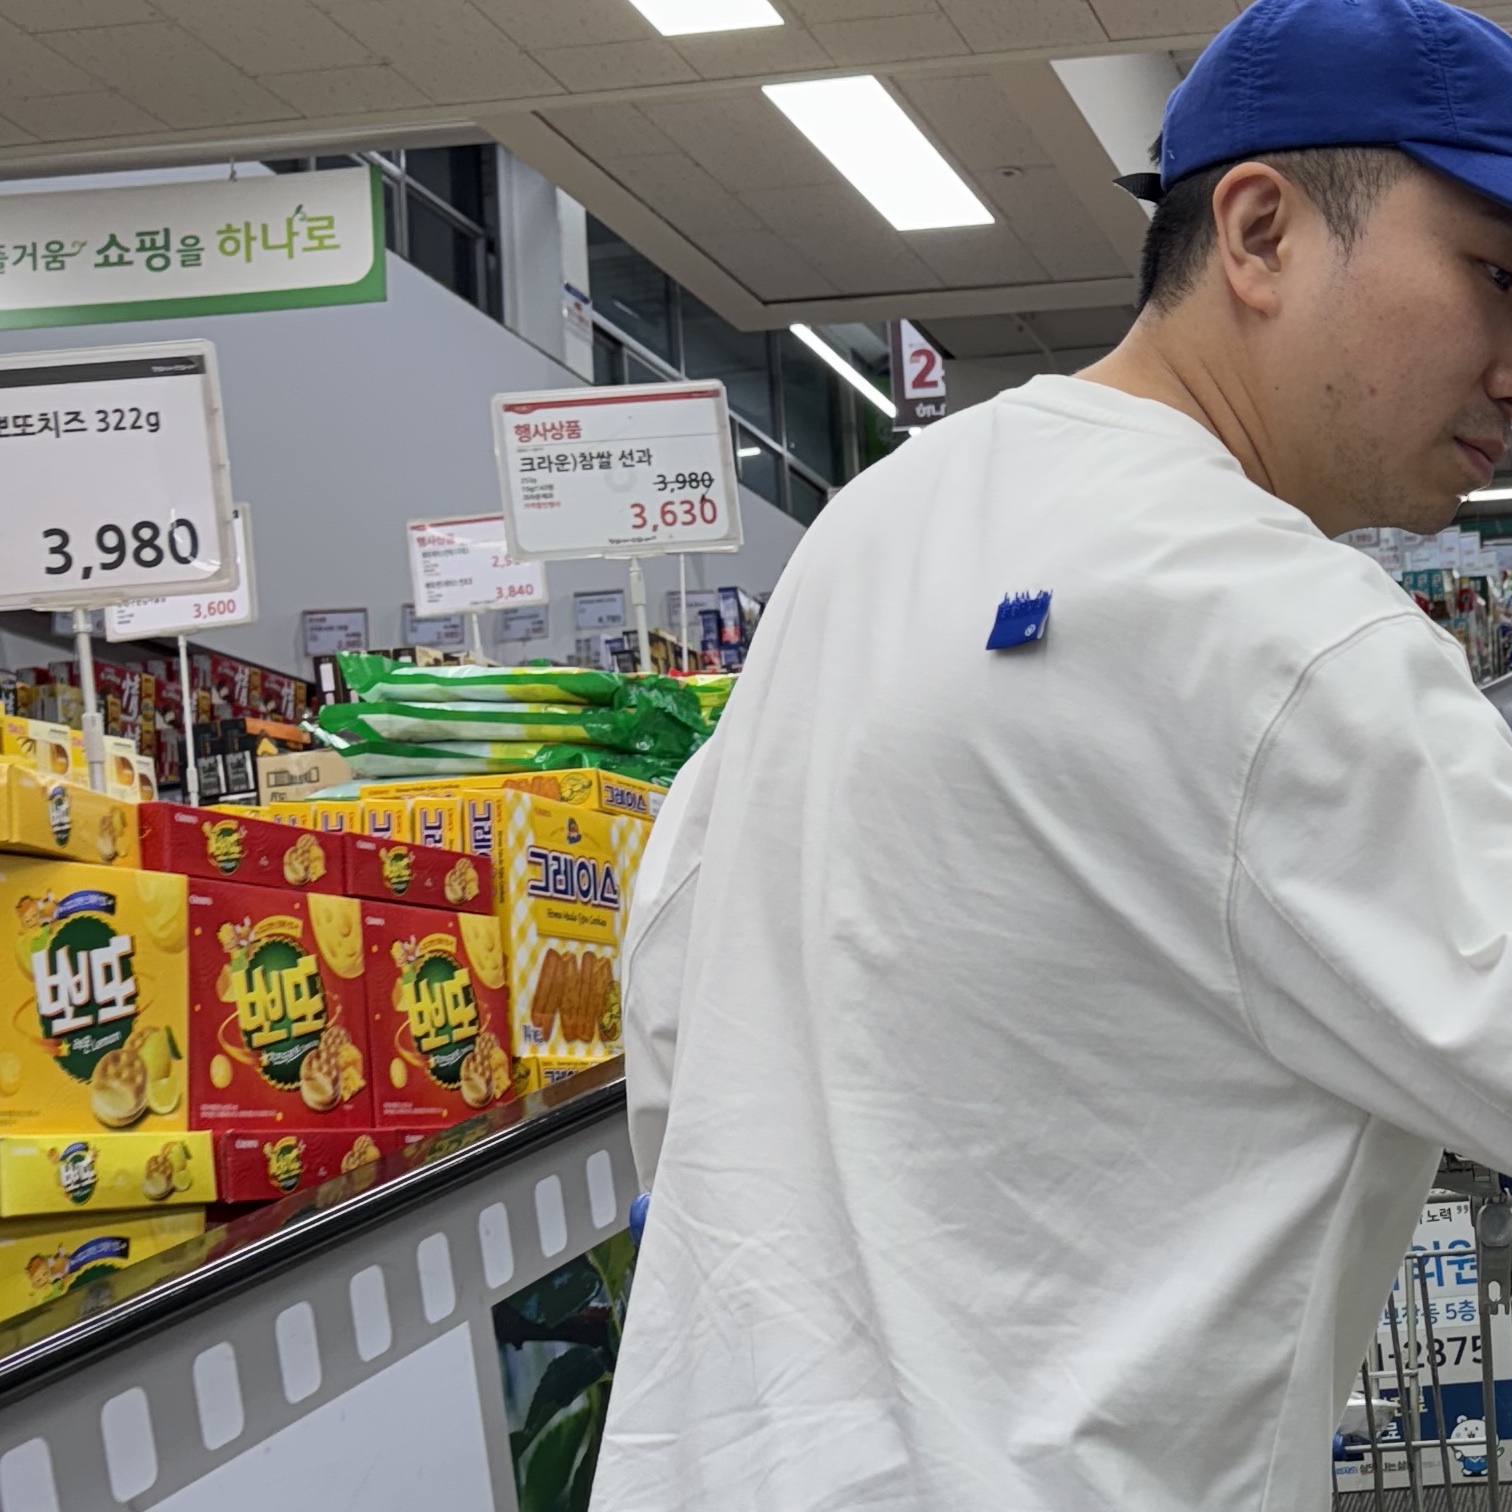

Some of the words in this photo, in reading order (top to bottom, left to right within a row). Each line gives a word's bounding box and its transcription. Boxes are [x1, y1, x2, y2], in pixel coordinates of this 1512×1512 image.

[0, 239, 67, 274] 거움
[94, 227, 206, 273] 쇼핑을
[216, 214, 341, 264] 하나로
[95, 407, 161, 433] 322g
[514, 419, 583, 444] 행사상품
[518, 450, 613, 474] 크라운)참쌀
[618, 447, 653, 469] 선과
[654, 471, 715, 494] 3,980
[629, 497, 719, 533] 3,630
[42, 518, 199, 580] 3,980
[495, 583, 535, 601] 3,840
[193, 598, 237, 619] 3,600
[527, 845, 621, 910] 그레이스
[31, 934, 142, 1037] 뽀또
[231, 954, 328, 1049] 뽀또
[403, 968, 482, 1052] 뽀또
[1427, 1207, 1453, 1224] 노력
[1393, 1239, 1479, 1291] 의원
[1445, 1299, 1476, 1322] 5층
